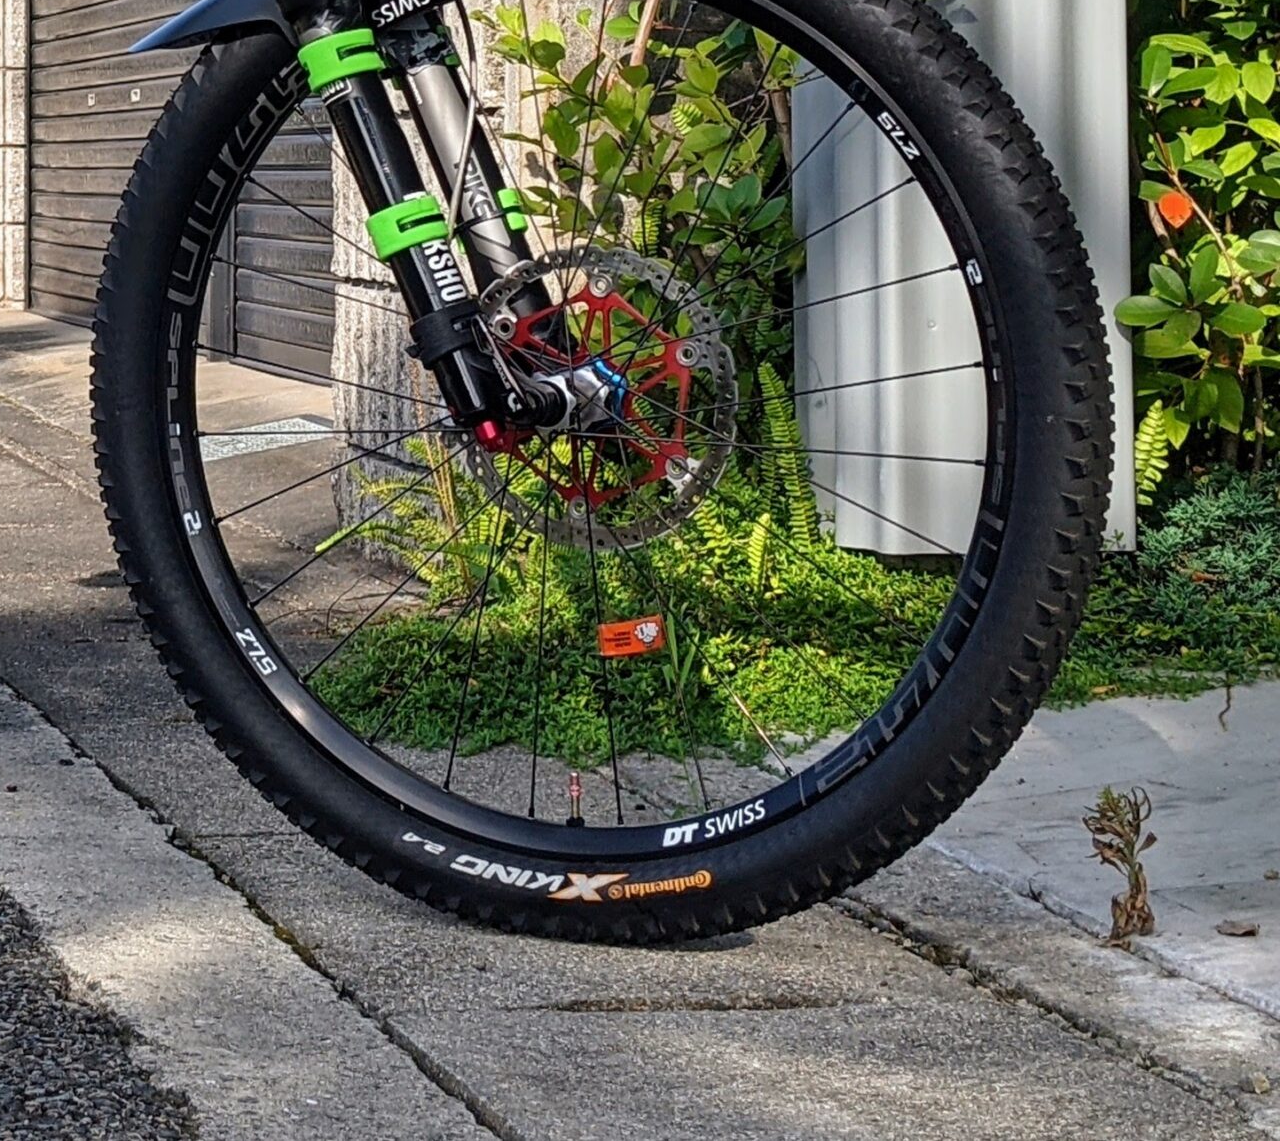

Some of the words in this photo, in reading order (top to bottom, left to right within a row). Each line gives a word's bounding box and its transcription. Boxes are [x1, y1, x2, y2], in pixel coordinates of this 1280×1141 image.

[876, 111, 921, 161] 27.5
[235, 628, 278, 676] 27.5
[402, 830, 447, 856] 2.4
[662, 822, 700, 848] DT
[703, 798, 766, 839] SWISS
[624, 868, 713, 899] Continental
